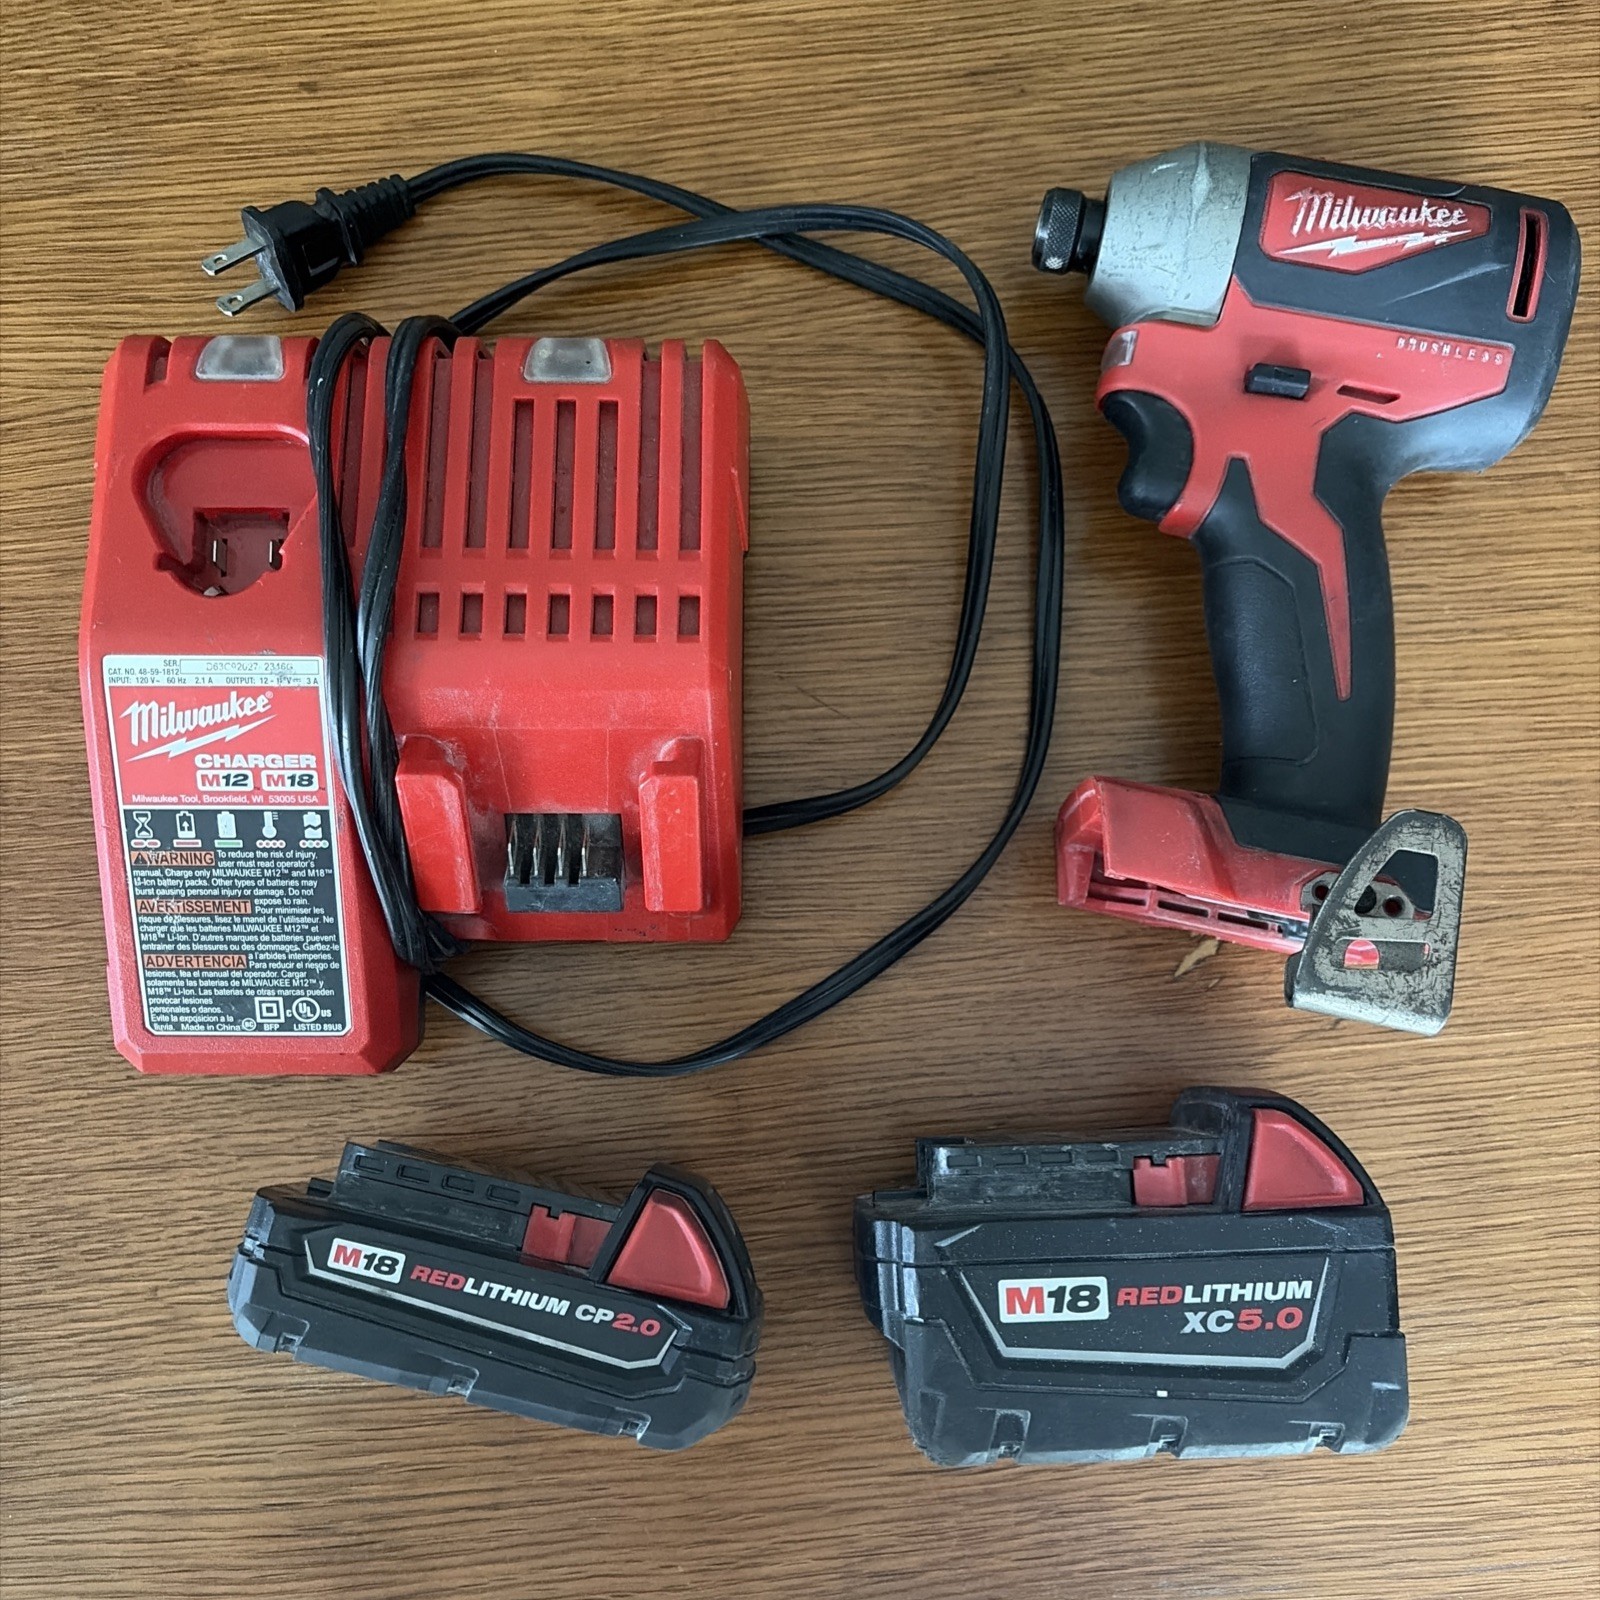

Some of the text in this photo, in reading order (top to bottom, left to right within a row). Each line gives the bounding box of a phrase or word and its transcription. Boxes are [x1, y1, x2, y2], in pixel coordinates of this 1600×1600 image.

[1284, 186, 1468, 238] Milwaukee
[1397, 337, 1504, 366] BRUSHLESS
[194, 754, 316, 768] CHARGER
[132, 795, 178, 804] Milwaukee
[204, 795, 250, 804] Brookfield,
[252, 795, 263, 804] WI
[269, 795, 295, 804] 53005
[298, 795, 318, 804] USA
[147, 852, 214, 864] WARNING
[216, 850, 226, 858] To
[228, 850, 254, 858] reduce
[256, 850, 268, 858] the
[270, 850, 284, 858] risk
[286, 850, 294, 858] of
[276, 860, 315, 869] operator's
[165, 869, 192, 878] Charge
[194, 869, 210, 878] only
[157, 878, 183, 888] battery
[185, 878, 210, 887] packs.
[234, 879, 255, 888] types
[156, 888, 185, 897] causing
[187, 888, 219, 897] personal
[221, 888, 242, 897] injury
[253, 888, 286, 897] damage.
[140, 901, 249, 912] AVERTISSEMENT
[139, 916, 161, 924] risque
[140, 925, 168, 934] charger
[226, 935, 258, 943] marques
[288, 952, 333, 961] intemperies.
[146, 956, 246, 967] ADVERTENCIA
[305, 962, 328, 970] riesgo
[145, 970, 178, 978] lesiones,
[244, 970, 279, 979] operador.
[281, 970, 306, 979] Cargar
[307, 988, 334, 997] pueden
[150, 1006, 190, 1014] personales
[332, 1244, 662, 1337] M18 REDLITHIUM CP2.0
[1006, 1280, 1313, 1315] M18 REDLITHIUM
[1180, 1306, 1303, 1334] XC5.0
